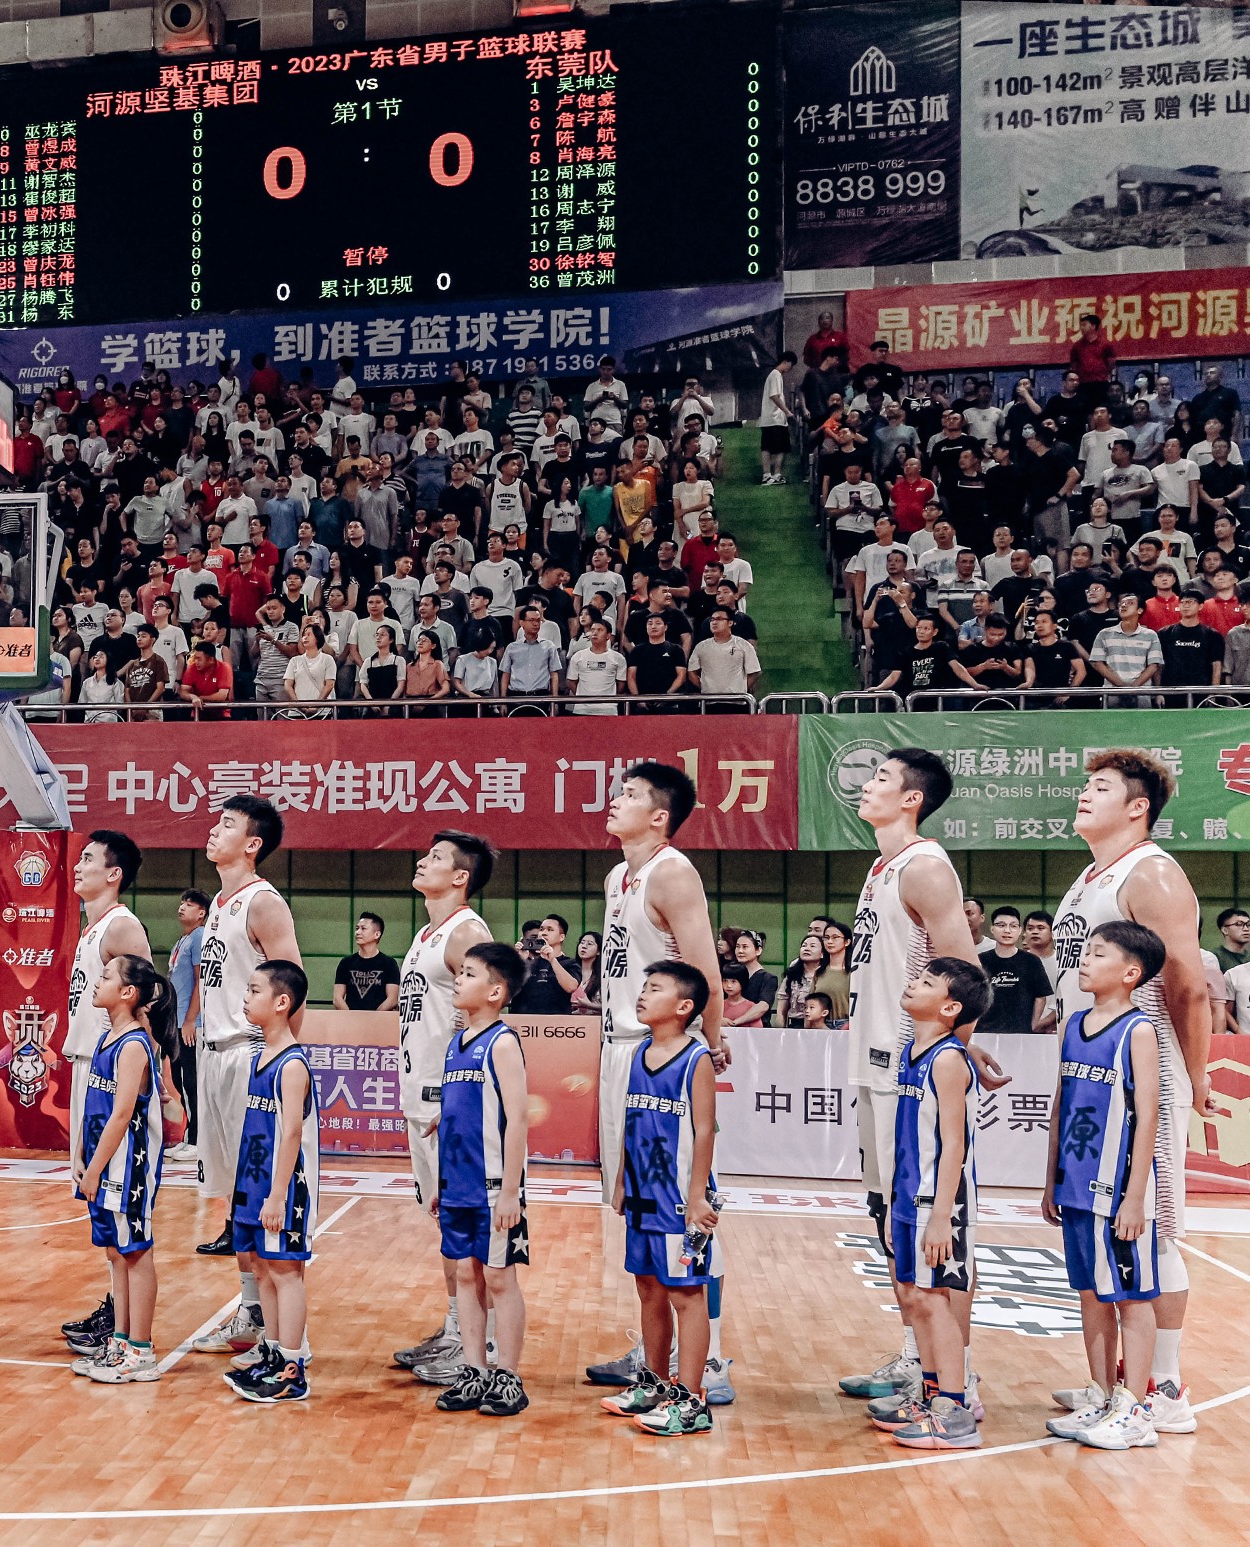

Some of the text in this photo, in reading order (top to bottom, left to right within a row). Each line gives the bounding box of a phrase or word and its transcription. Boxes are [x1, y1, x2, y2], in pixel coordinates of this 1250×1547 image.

[973, 7, 1201, 59] 一座生态城
[525, 49, 620, 80] 东莞队
[748, 63, 758, 75] 0
[530, 73, 617, 95] 1 吴坤达
[748, 81, 758, 93] 0
[86, 80, 260, 118] 河源坚基集团
[529, 91, 617, 112] 3 卢健豪
[748, 99, 759, 111] 0
[794, 93, 951, 135] 保利生态城
[529, 116, 542, 130] 6
[748, 117, 758, 129] 0
[0, 129, 10, 141] 0
[530, 133, 541, 147] 7
[748, 135, 758, 147] 0
[0, 145, 10, 158] 8
[429, 132, 475, 187] 0
[529, 144, 617, 165] 8 肖海亮
[748, 153, 758, 165] 0
[0, 155, 78, 175] 9 黄文威
[263, 146, 307, 200] 0
[530, 162, 617, 182] 12 周泽源
[0, 170, 76, 191] 11 谢智杰
[748, 172, 758, 184] 0
[530, 186, 550, 200] 13
[748, 189, 758, 202] 0
[796, 169, 946, 205] 8838 999
[0, 194, 17, 207] 13
[530, 198, 616, 218] 16 周志宁
[0, 205, 77, 224] 15 曾冰强
[748, 208, 758, 220] 0
[0, 227, 17, 241] 17
[530, 221, 550, 235] 17
[748, 226, 759, 237] 0
[0, 243, 17, 257] 18
[530, 233, 616, 253] 19 吕彦佩
[748, 244, 758, 256] 0
[342, 246, 389, 267] 暂停
[529, 251, 616, 271] 30 徐铭智
[748, 262, 758, 274] 0
[318, 275, 413, 299] 累计犯规
[436, 272, 451, 290] 0
[529, 269, 616, 289] 36 曾茂洲
[276, 283, 291, 301] 0
[874, 288, 1250, 354] 晶源矿业预祝河源
[4, 644, 32, 657] 准者
[984, 783, 1034, 799] Oasis
[23, 872, 43, 885] GD
[16, 947, 55, 966] 准者
[521, 1025, 586, 1039] 311 6666
[403, 1050, 412, 1074] 3
[13, 1079, 42, 1093] 2023
[197, 1159, 205, 1183] 8
